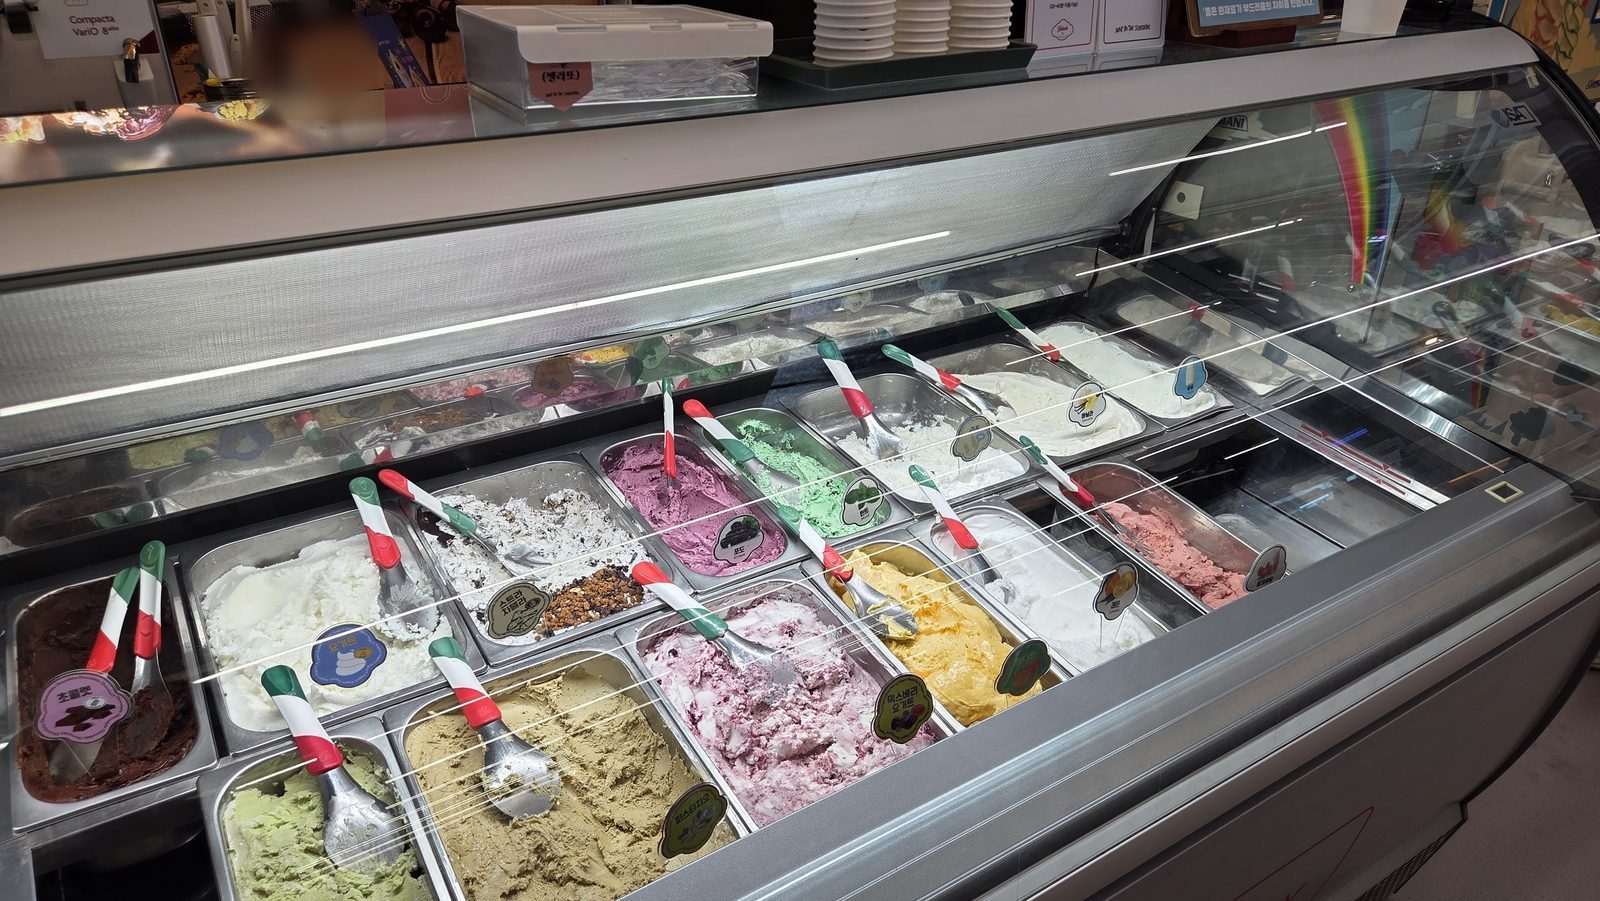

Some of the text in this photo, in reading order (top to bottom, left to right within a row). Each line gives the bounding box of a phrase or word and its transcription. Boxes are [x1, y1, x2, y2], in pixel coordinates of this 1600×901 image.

[69, 15, 115, 25] Compacta
[500, 590, 523, 609] 스트라
[887, 685, 918, 703] 믹스베리
[892, 697, 915, 713] 요거트
